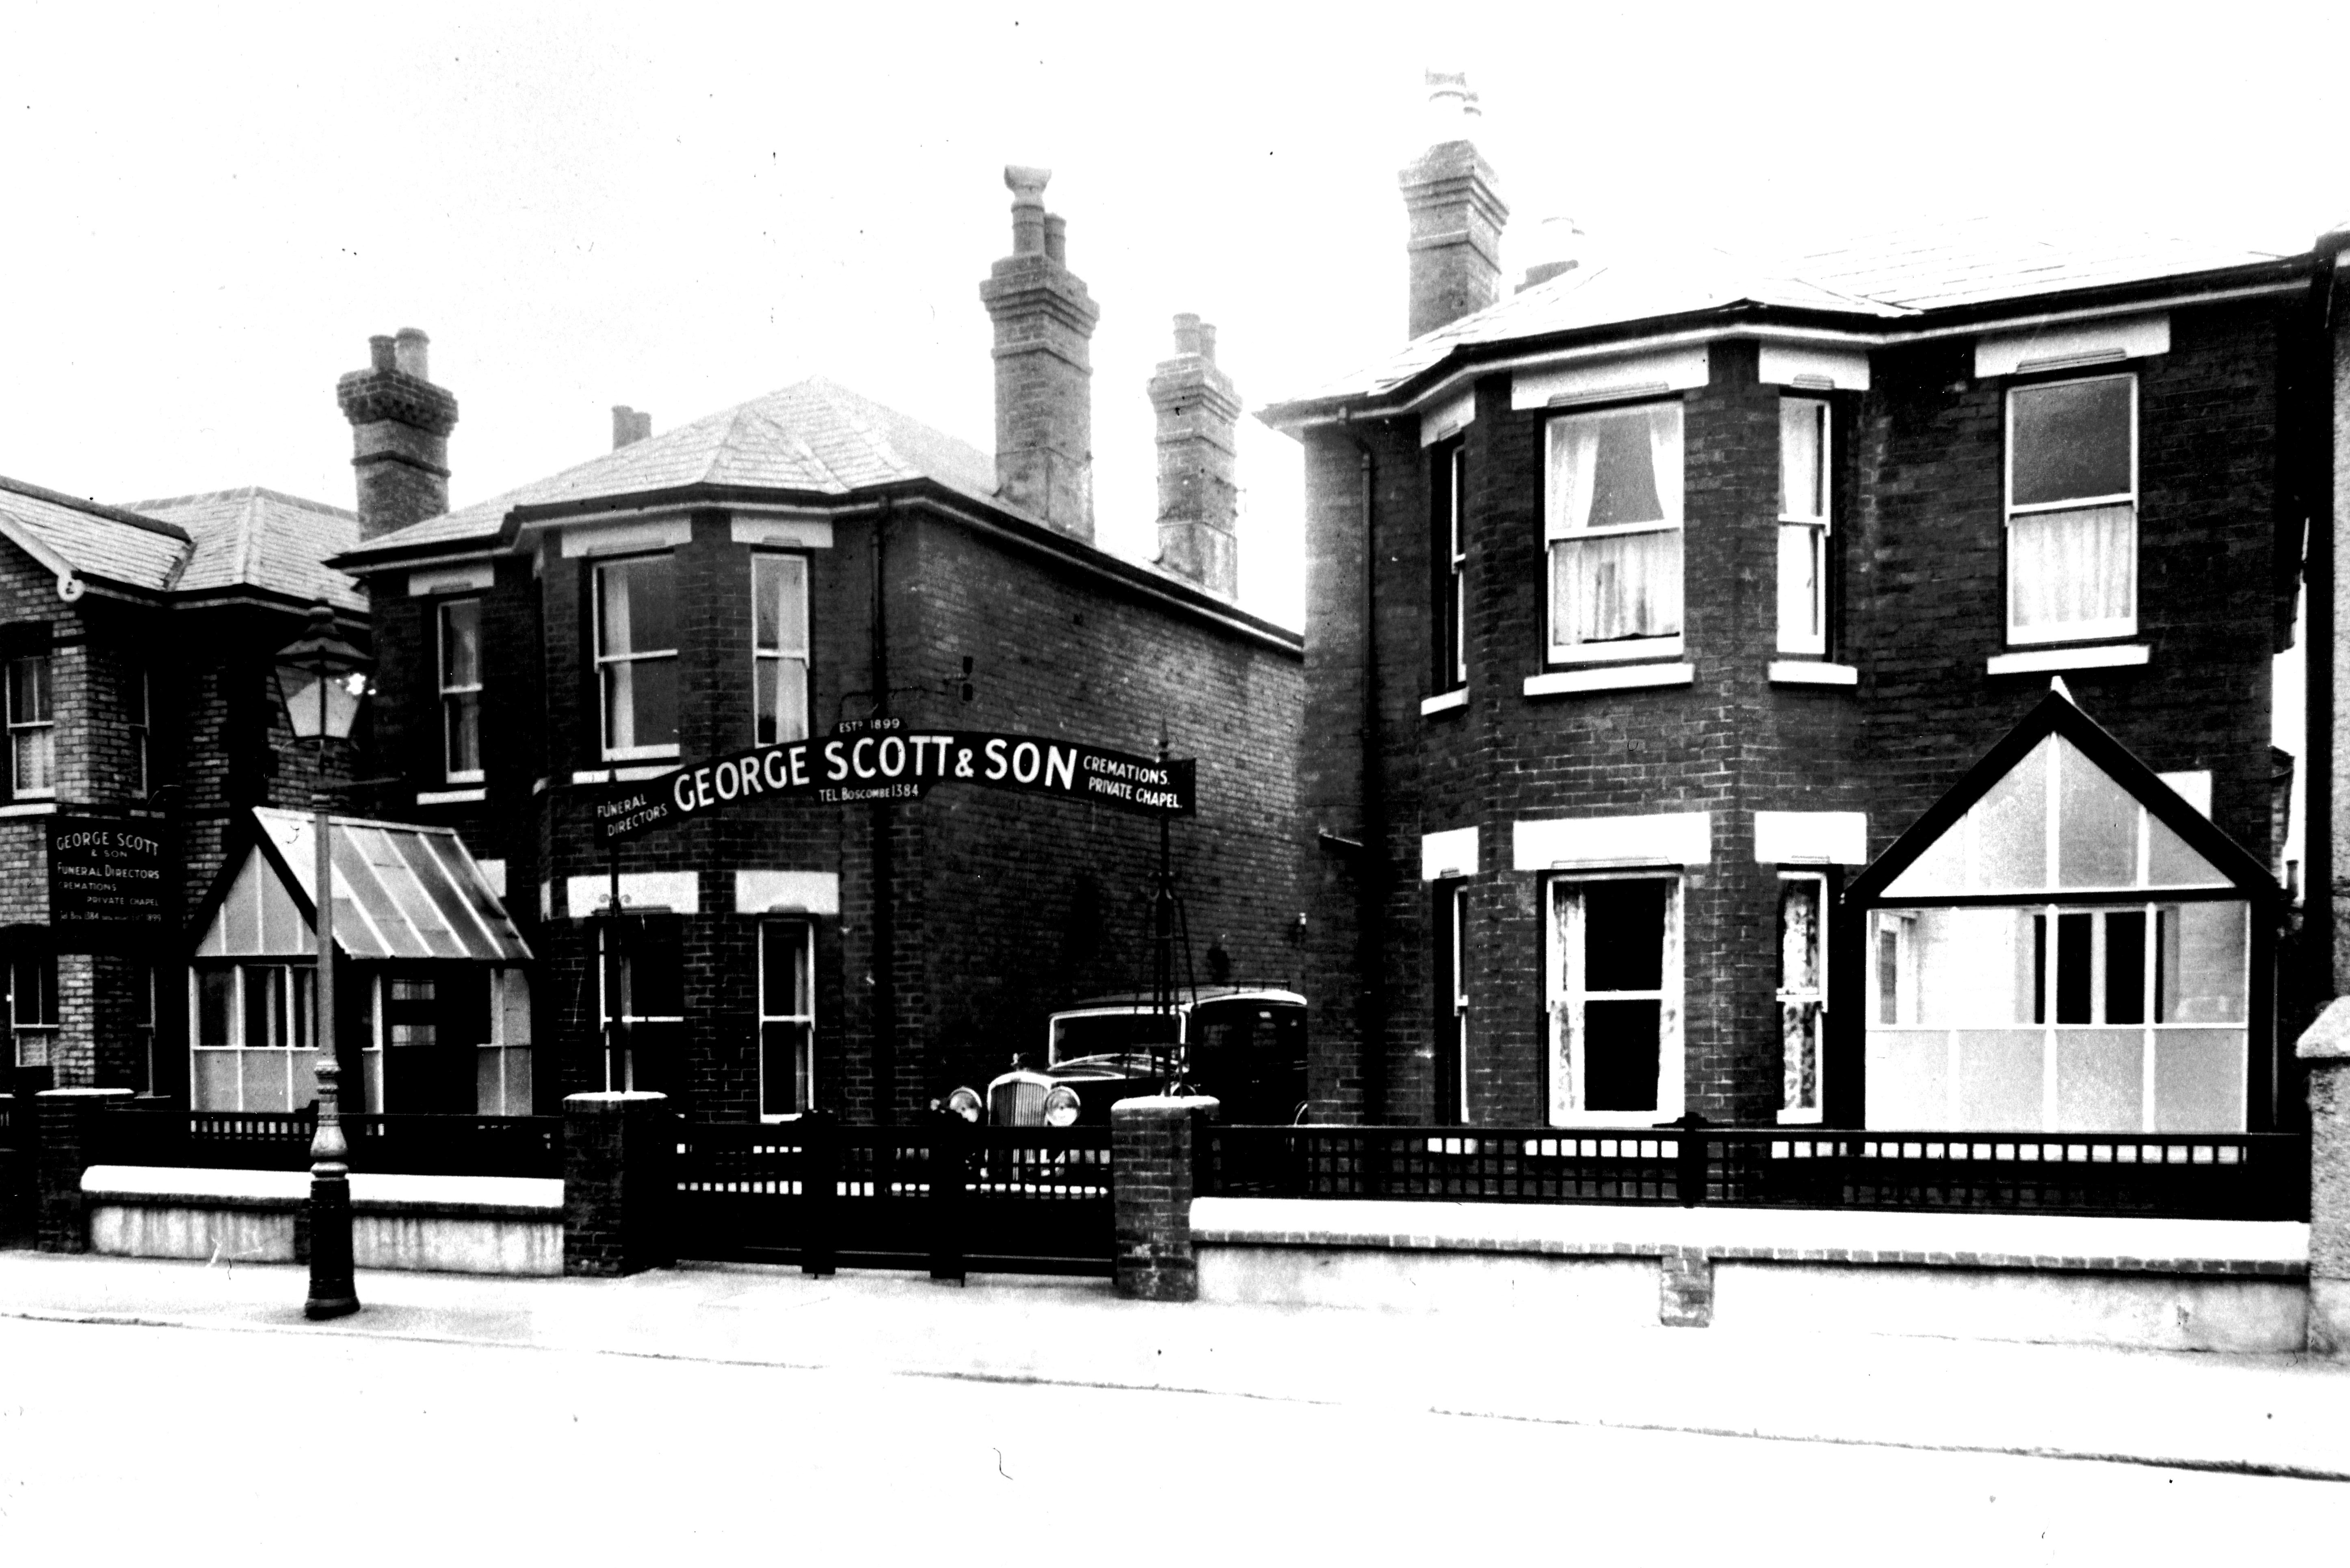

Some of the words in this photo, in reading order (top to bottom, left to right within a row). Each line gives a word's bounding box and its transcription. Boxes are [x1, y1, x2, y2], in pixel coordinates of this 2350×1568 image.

[870, 718, 900, 730] 1899
[673, 746, 810, 812] GEORGE
[824, 735, 954, 781] SCOTT
[955, 748, 974, 778] &
[985, 738, 1078, 790] SON
[892, 784, 918, 797] 1384
[1088, 776, 1133, 800] PRIVATE
[597, 794, 647, 818] FUNERAL
[607, 803, 668, 837] DIRECTORS
[56, 831, 110, 850] GEORGE
[117, 833, 159, 856] SCOTT
[57, 862, 102, 876] FUNERAL
[104, 864, 160, 879] DIRECTORS
[58, 882, 117, 891] CREMATIONS
[87, 896, 125, 905] PRIVATE
